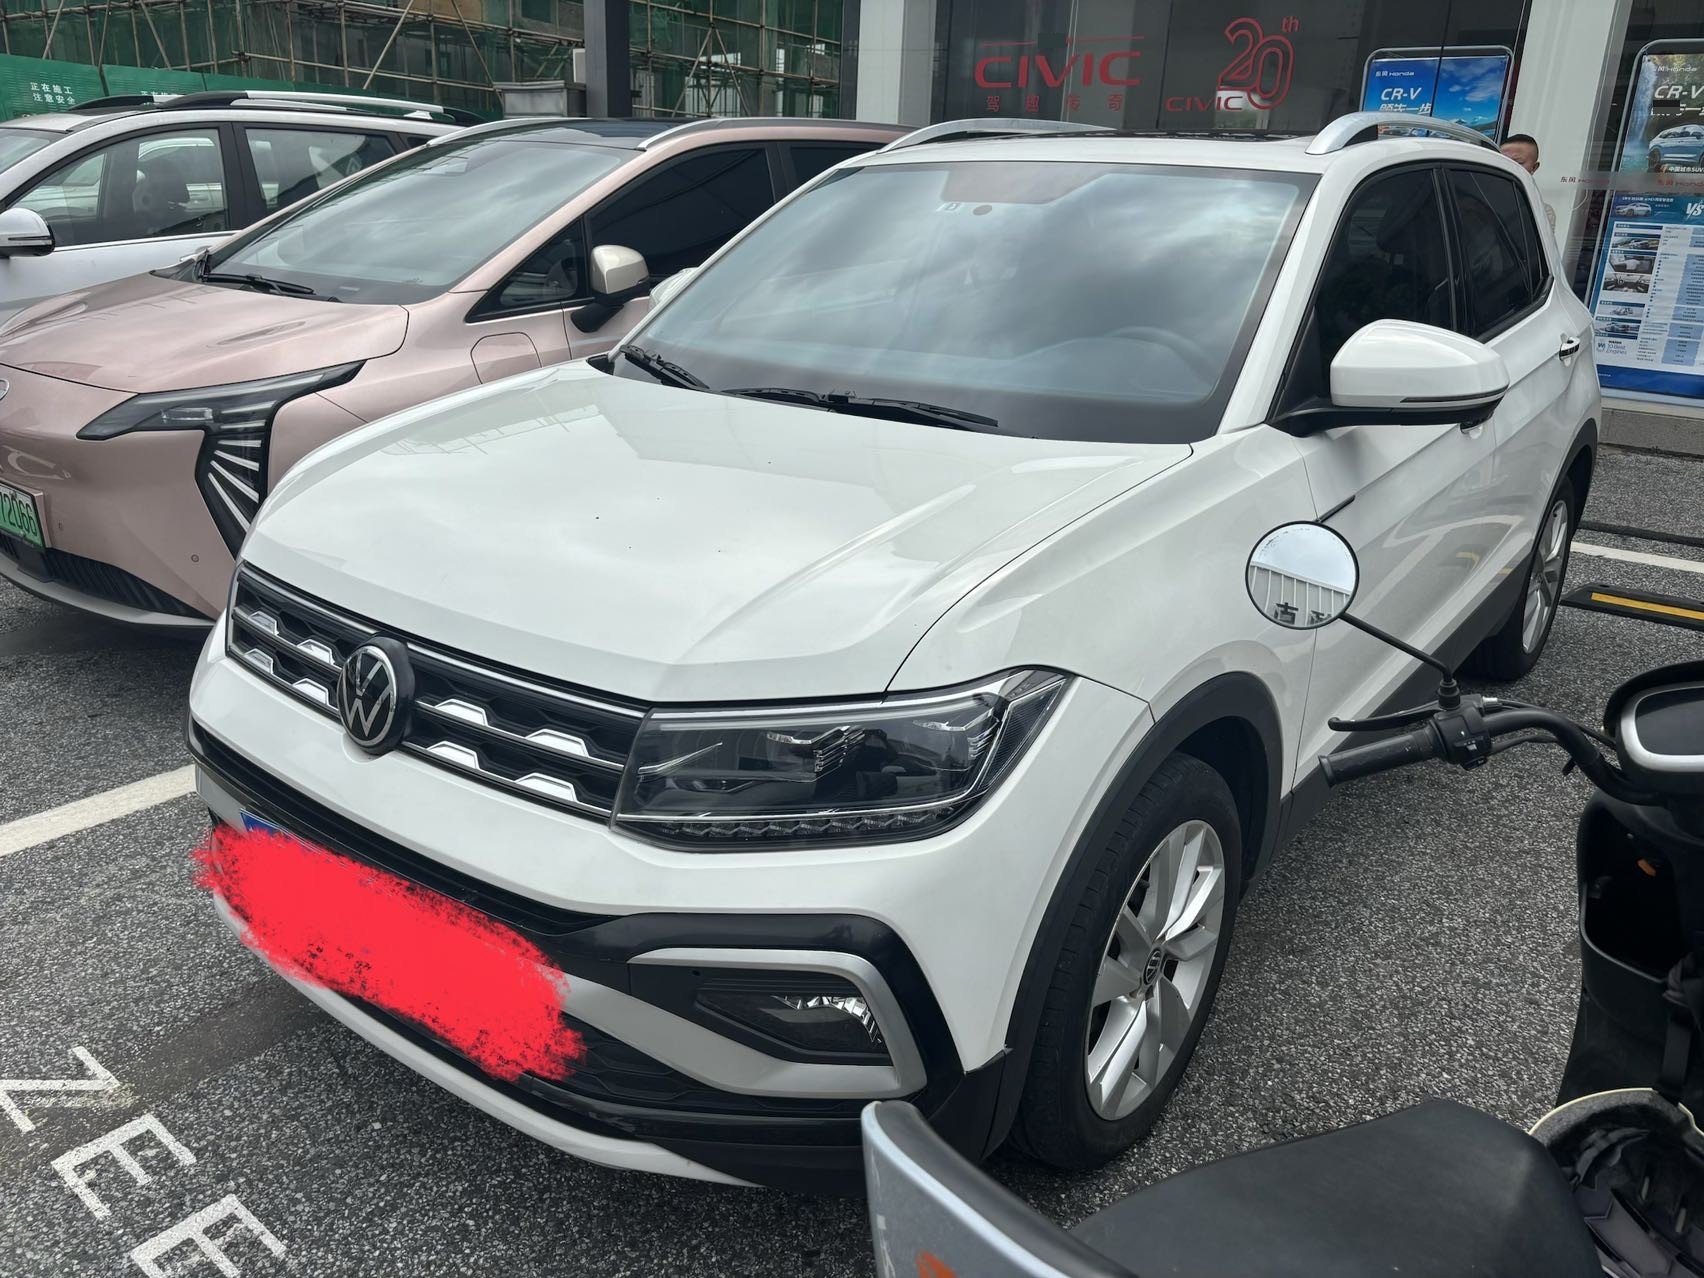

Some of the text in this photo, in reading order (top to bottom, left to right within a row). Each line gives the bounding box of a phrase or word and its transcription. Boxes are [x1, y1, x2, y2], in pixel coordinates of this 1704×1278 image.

[974, 50, 1143, 89] CIVIC
[30, 82, 73, 95] 正在施工
[1380, 87, 1422, 101] CR-V
[32, 92, 76, 105] 注意安全
[1164, 95, 1243, 112] CIVIC
